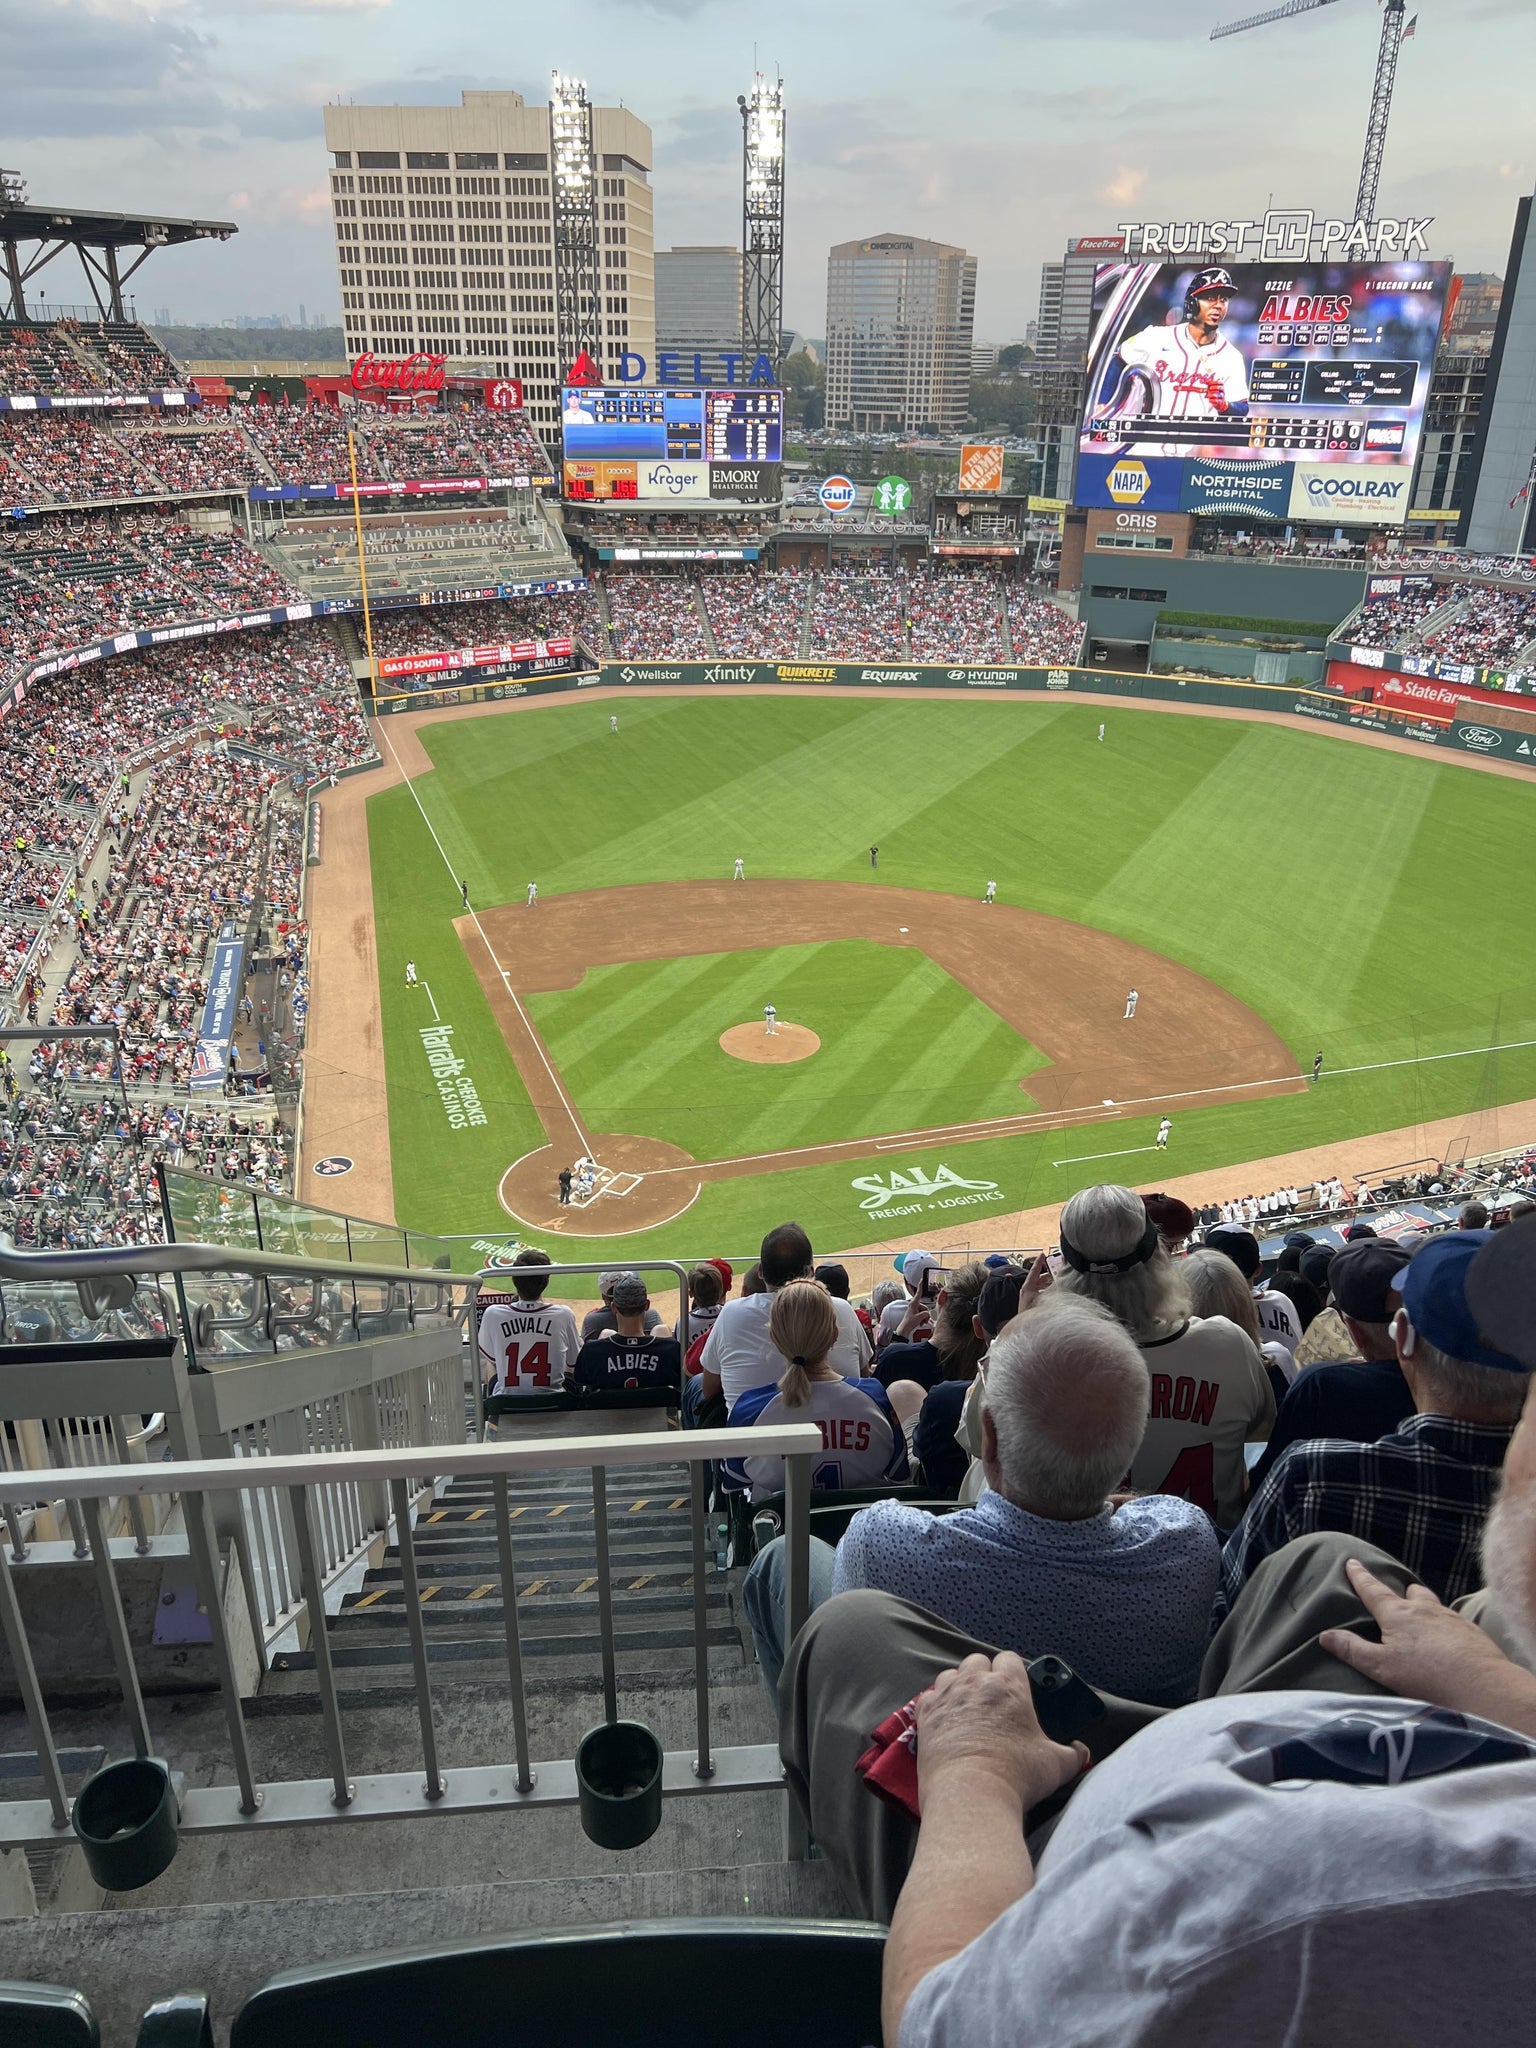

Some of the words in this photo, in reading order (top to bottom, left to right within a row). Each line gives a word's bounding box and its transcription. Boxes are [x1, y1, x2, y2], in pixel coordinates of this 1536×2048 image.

[1118, 221, 1255, 254] TRUIST
[1321, 217, 1435, 252] PARK
[1080, 240, 1120, 249] RaceTrac
[1265, 281, 1293, 291] OZZIE
[1376, 281, 1408, 290] SECOND
[1411, 281, 1433, 290] BASE
[1259, 295, 1352, 323] ALBIES
[621, 352, 775, 385] DELTA
[1125, 422, 1132, 430] 0
[1255, 427, 1262, 435] 0
[1285, 427, 1293, 435] 0
[1301, 428, 1308, 436] 0
[1316, 428, 1323, 436] 2
[1333, 426, 1343, 438] 0
[1349, 426, 1360, 439] 0
[1253, 438, 1260, 447] 0
[1269, 439, 1275, 447] 0
[1284, 439, 1290, 448] 0
[1299, 440, 1306, 448] 0
[1314, 439, 1322, 448] 2
[965, 450, 984, 468] THE
[577, 465, 596, 473] MEGA
[961, 446, 1003, 490] HOME
[976, 463, 1002, 489] DEPOT
[649, 465, 698, 494] Kroger
[713, 470, 760, 483] EMORY
[1113, 473, 1143, 491] NAPA
[1190, 474, 1283, 490] NORTHSIDE
[821, 488, 854, 501] Gulf
[1206, 489, 1264, 499] HOSPITAL
[1308, 478, 1405, 498] COOLRAY
[1336, 503, 1363, 511] Plumbing
[1116, 513, 1157, 528] ORIS
[384, 662, 403, 673] GAS
[413, 659, 443, 669] SOUTH
[545, 657, 570, 669] MLB+
[437, 669, 463, 681] MLB+
[638, 670, 681, 681] Wellstar
[704, 665, 757, 683] xfinity
[777, 666, 836, 678] QUIKRETE
[861, 670, 920, 683] EQUIFAX
[968, 671, 1018, 681] HYUNDAI
[1048, 670, 1068, 678] PAPA
[1046, 677, 1069, 685] JOHNS
[1412, 730, 1437, 740] National
[1465, 729, 1494, 744] Ford
[217, 968, 232, 987] TRUIST
[214, 995, 227, 1011] PARK
[419, 1025, 466, 1079] Harrah's
[436, 1080, 468, 1129] CASINOS
[456, 1077, 488, 1127] CHEROKEE
[851, 1163, 999, 1209] SAIA
[938, 1191, 1005, 1209] LOGISTICS
[868, 1203, 923, 1220] FREIGHT
[501, 1317, 552, 1338] DUVALL
[1269, 1309, 1294, 1338] JR.
[505, 1342, 552, 1388] 14
[607, 1354, 659, 1373] ALBIES
[1152, 1374, 1220, 1426] RON
[812, 1419, 871, 1451] BIES
[813, 1461, 843, 1490] 1
